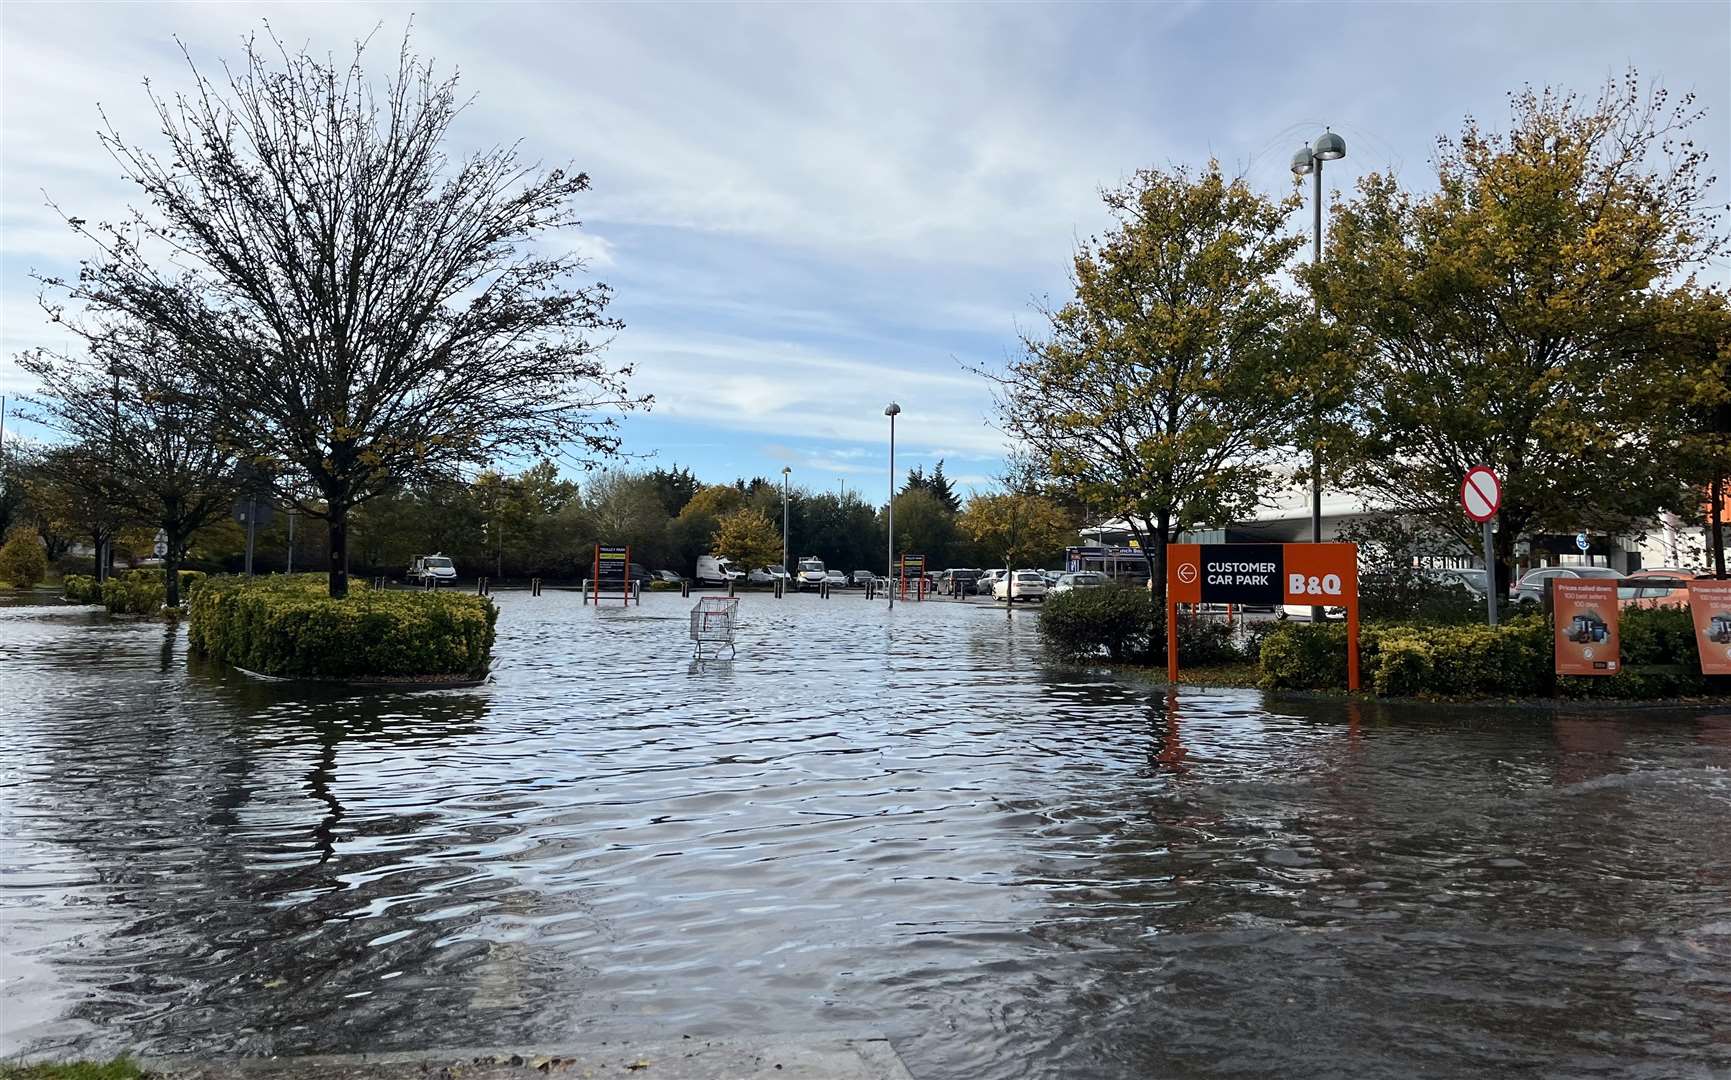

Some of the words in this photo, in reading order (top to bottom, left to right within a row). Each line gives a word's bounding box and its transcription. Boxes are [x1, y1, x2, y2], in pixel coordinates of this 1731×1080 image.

[1207, 562, 1275, 573] CUSTOMER
[1207, 575, 1232, 585] CAR
[1236, 575, 1269, 586] PARK
[1289, 573, 1342, 595] B&Q
